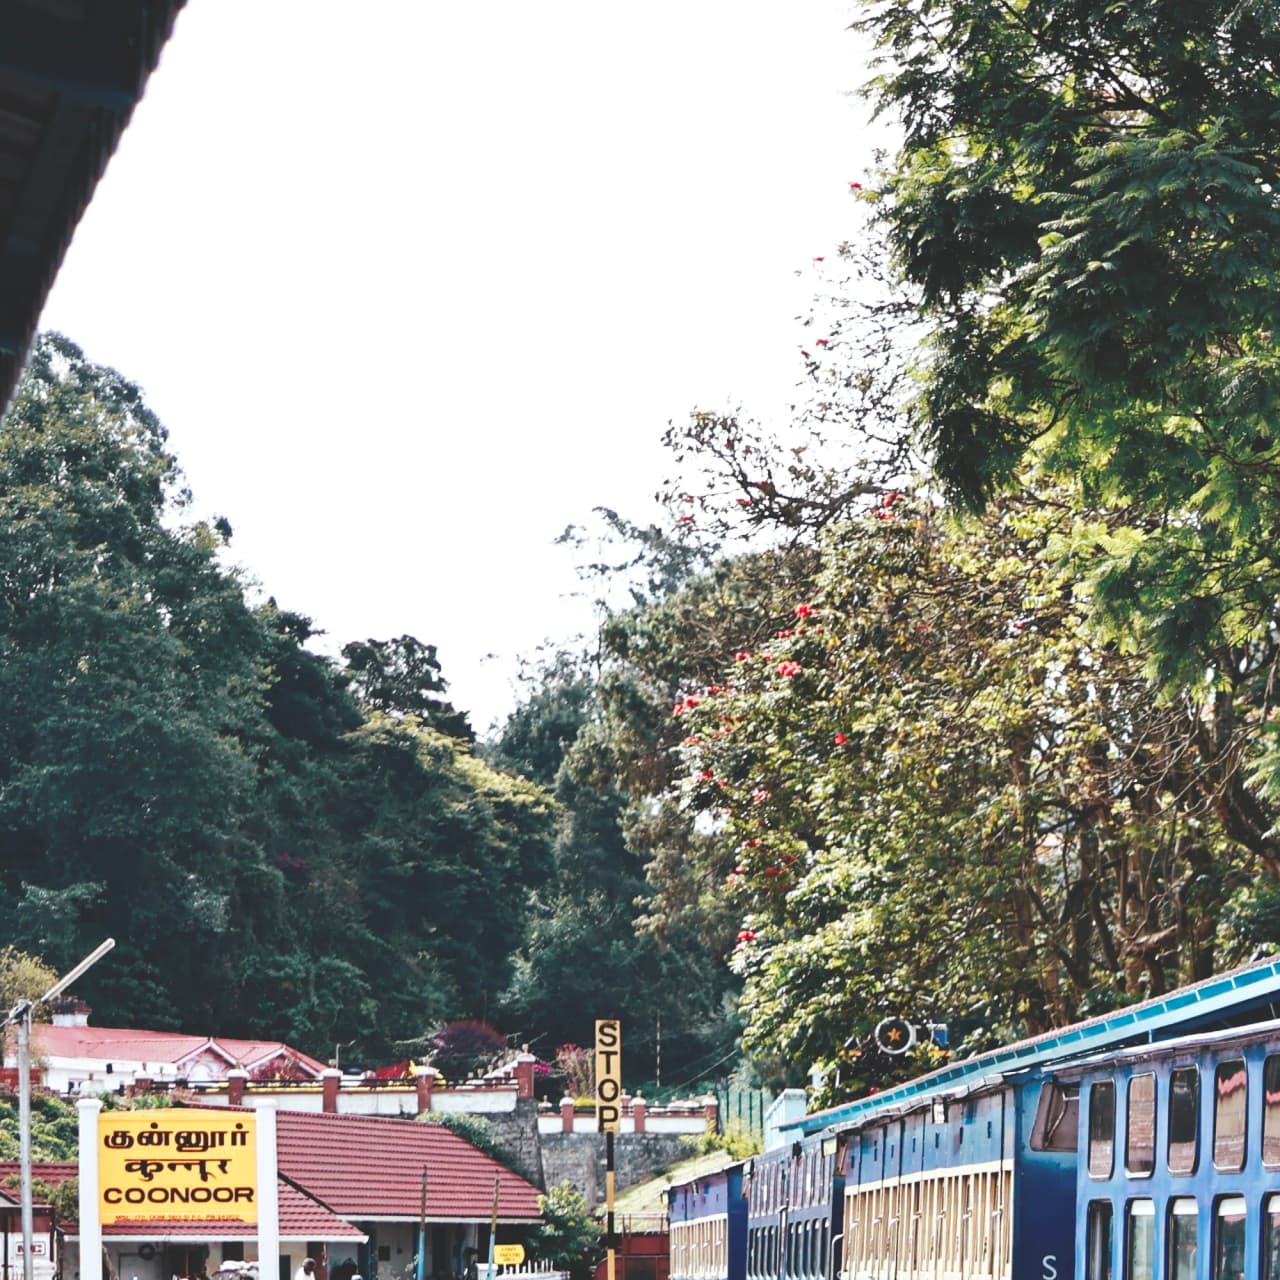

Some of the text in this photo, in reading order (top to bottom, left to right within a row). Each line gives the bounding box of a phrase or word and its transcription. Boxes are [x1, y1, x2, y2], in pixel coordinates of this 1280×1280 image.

[598, 1023, 619, 1133] STOP
[103, 1187, 254, 1204] COONOOR
[1042, 1255, 1057, 1280] S
